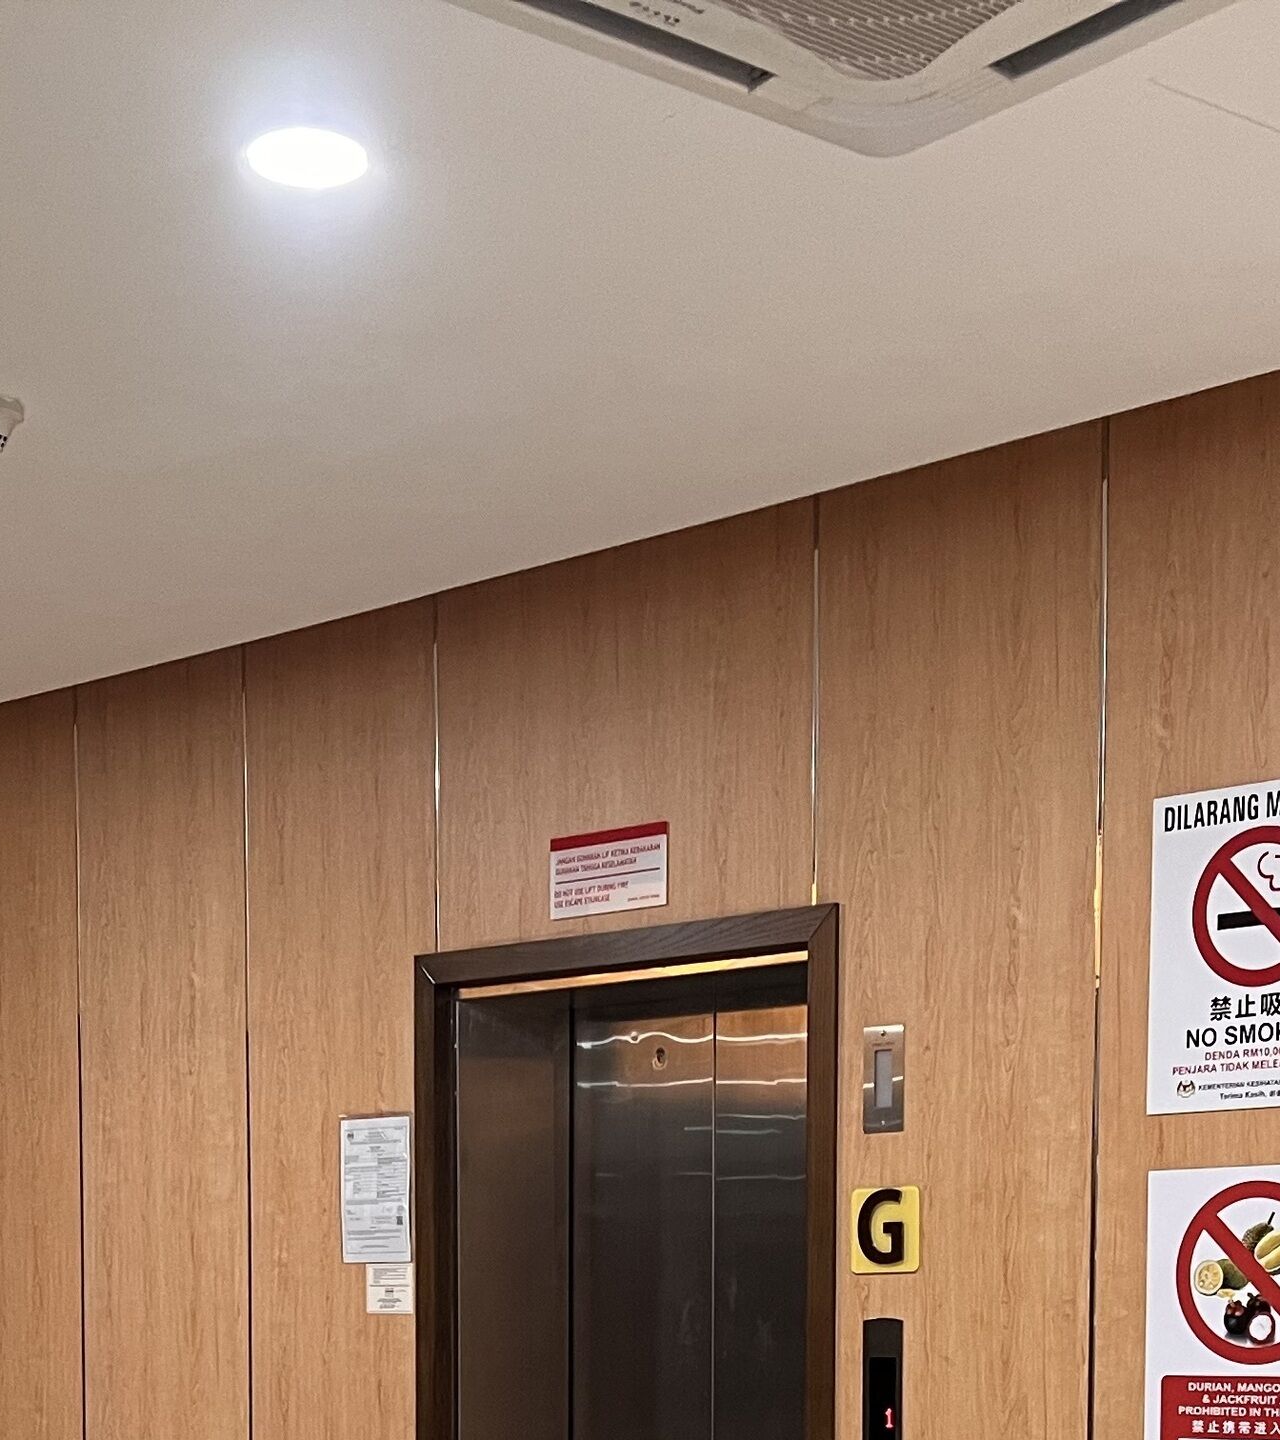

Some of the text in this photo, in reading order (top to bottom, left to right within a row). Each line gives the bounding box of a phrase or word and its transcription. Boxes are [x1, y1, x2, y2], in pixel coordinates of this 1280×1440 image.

[1164, 794, 1259, 832] DILARANG
[1186, 1027, 1217, 1049] NO
[1204, 1048, 1240, 1061] DENDA
[1172, 1063, 1217, 1076] PENJARA
[1220, 1062, 1249, 1073] TIDAK
[857, 1188, 905, 1265] G
[1188, 1382, 1234, 1393] DURIAN,
[1202, 1394, 1210, 1403] &
[1213, 1394, 1277, 1405] JACKFRUIT
[885, 1408, 894, 1428] 1
[1178, 1405, 1247, 1417] PROHIBITED
[1249, 1407, 1261, 1417] IN
